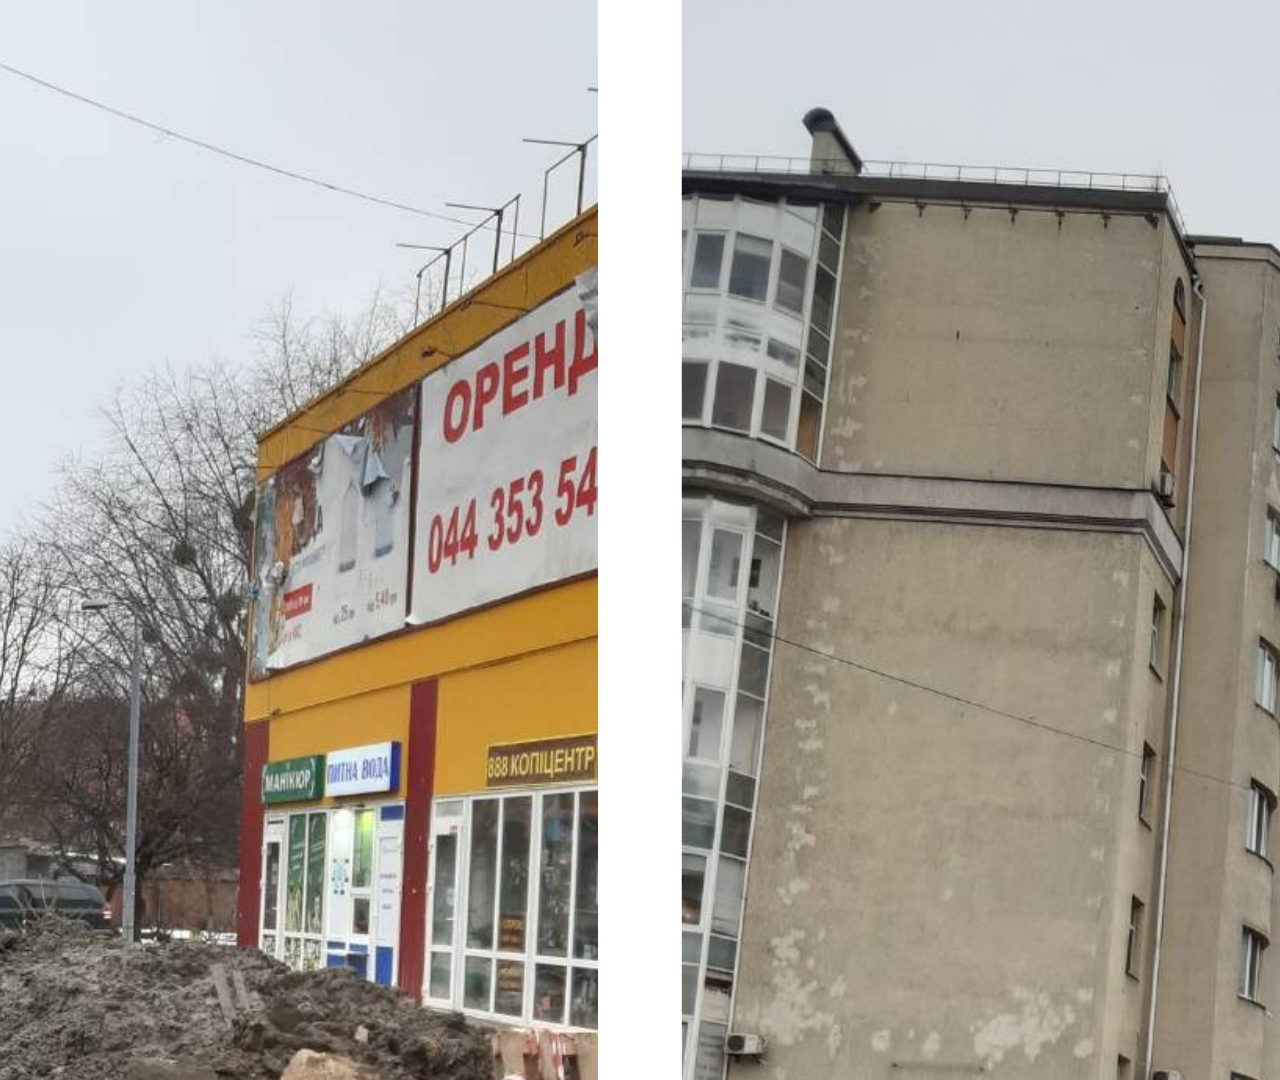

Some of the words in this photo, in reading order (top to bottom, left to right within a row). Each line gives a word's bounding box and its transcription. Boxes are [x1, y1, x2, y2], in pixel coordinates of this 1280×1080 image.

[428, 498, 478, 574] 044
[488, 469, 544, 552] 353
[556, 445, 598, 526] 54
[326, 761, 358, 784] ПИТНА
[361, 756, 389, 780] ВОДА
[510, 746, 595, 777] КОПІЦЕНТР
[264, 769, 311, 792] МАНІКЮР
